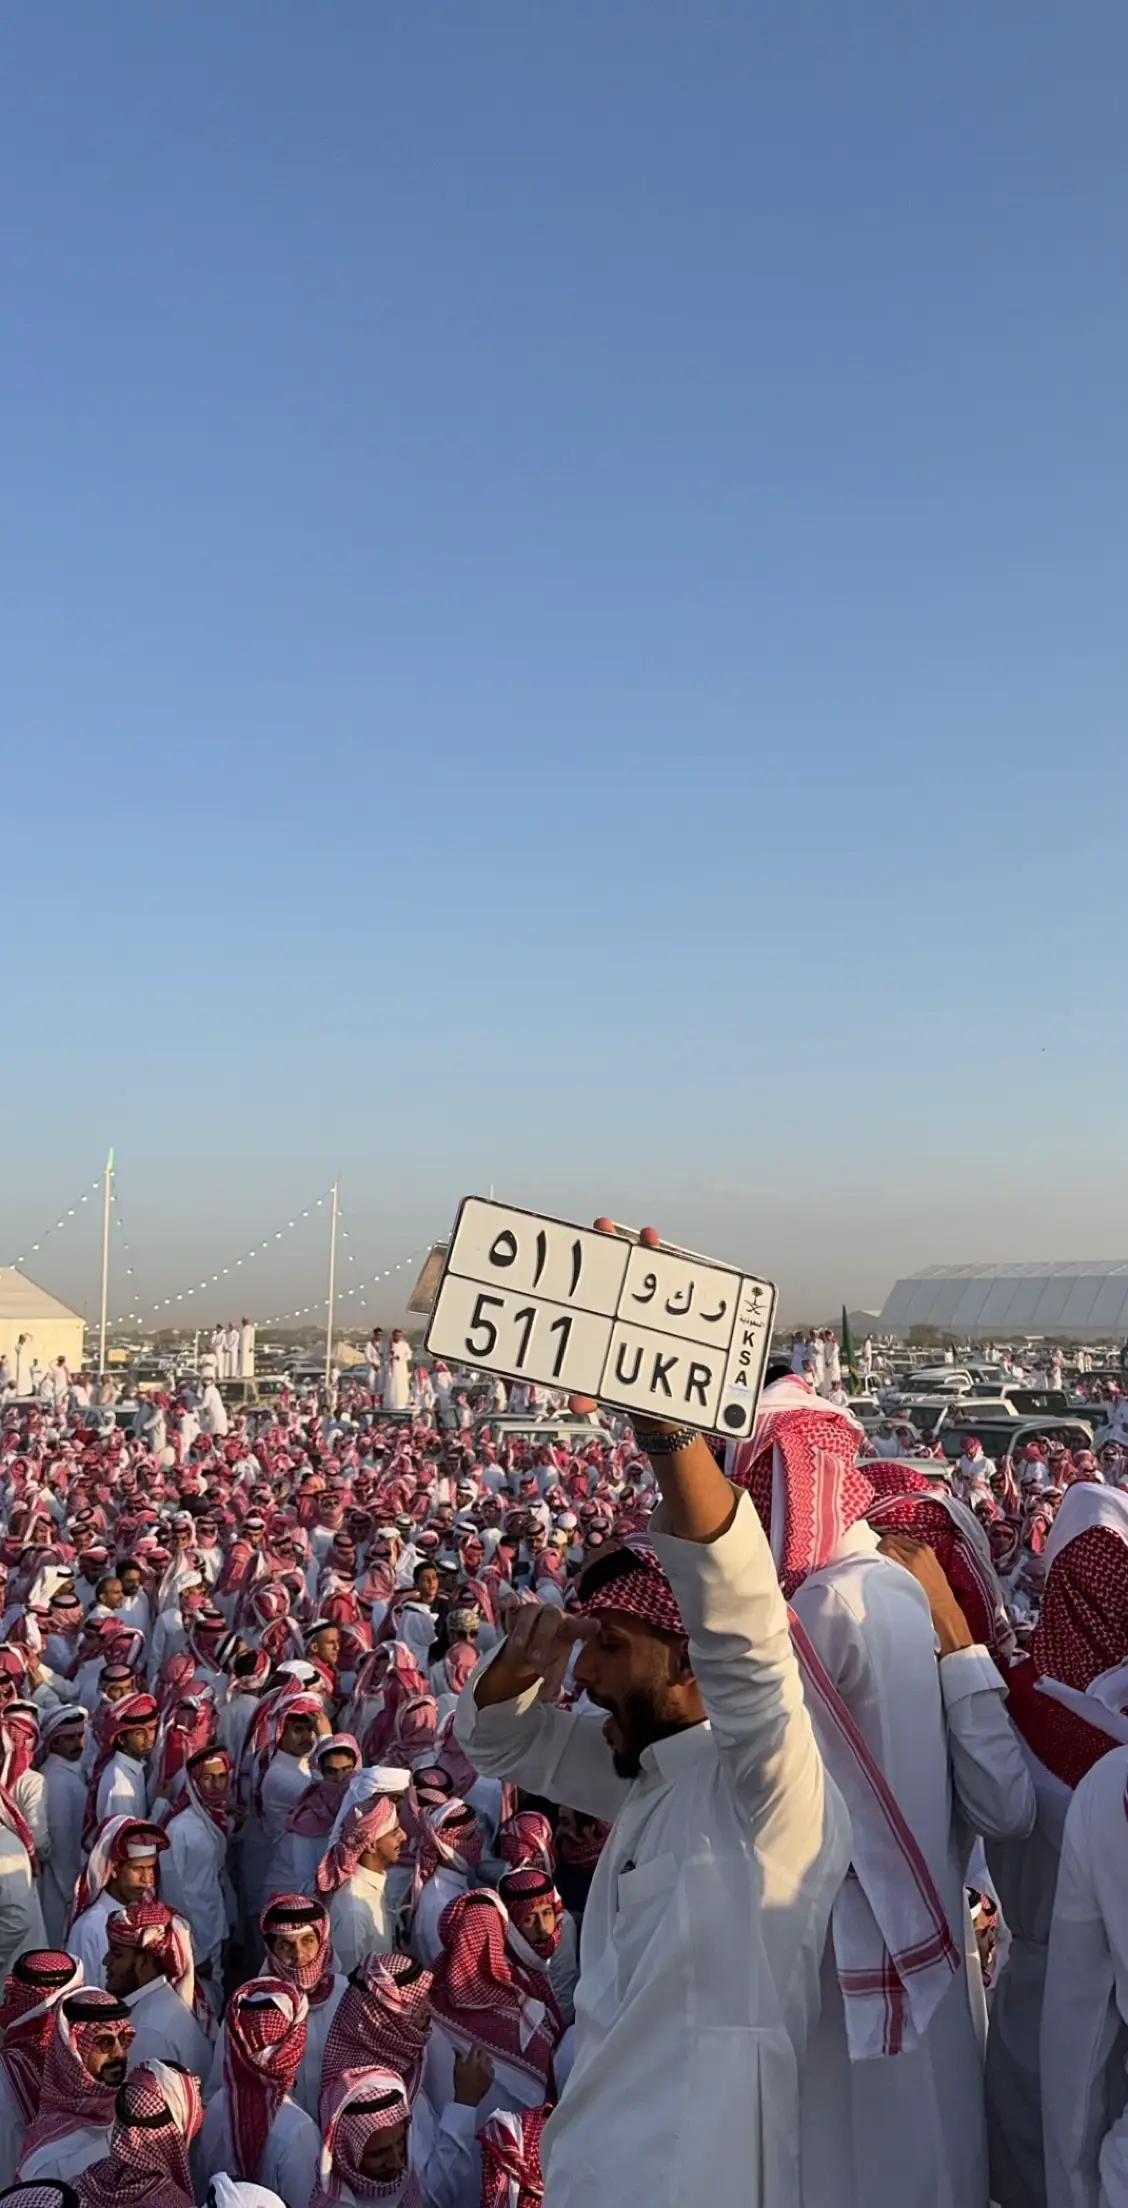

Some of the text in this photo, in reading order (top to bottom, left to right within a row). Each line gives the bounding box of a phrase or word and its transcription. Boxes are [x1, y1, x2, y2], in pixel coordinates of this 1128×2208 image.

[489, 1230, 582, 1297] ٥١١
[465, 1293, 573, 1378] 511
[735, 1330, 755, 1387] KSA
[615, 1343, 713, 1407] UKR
